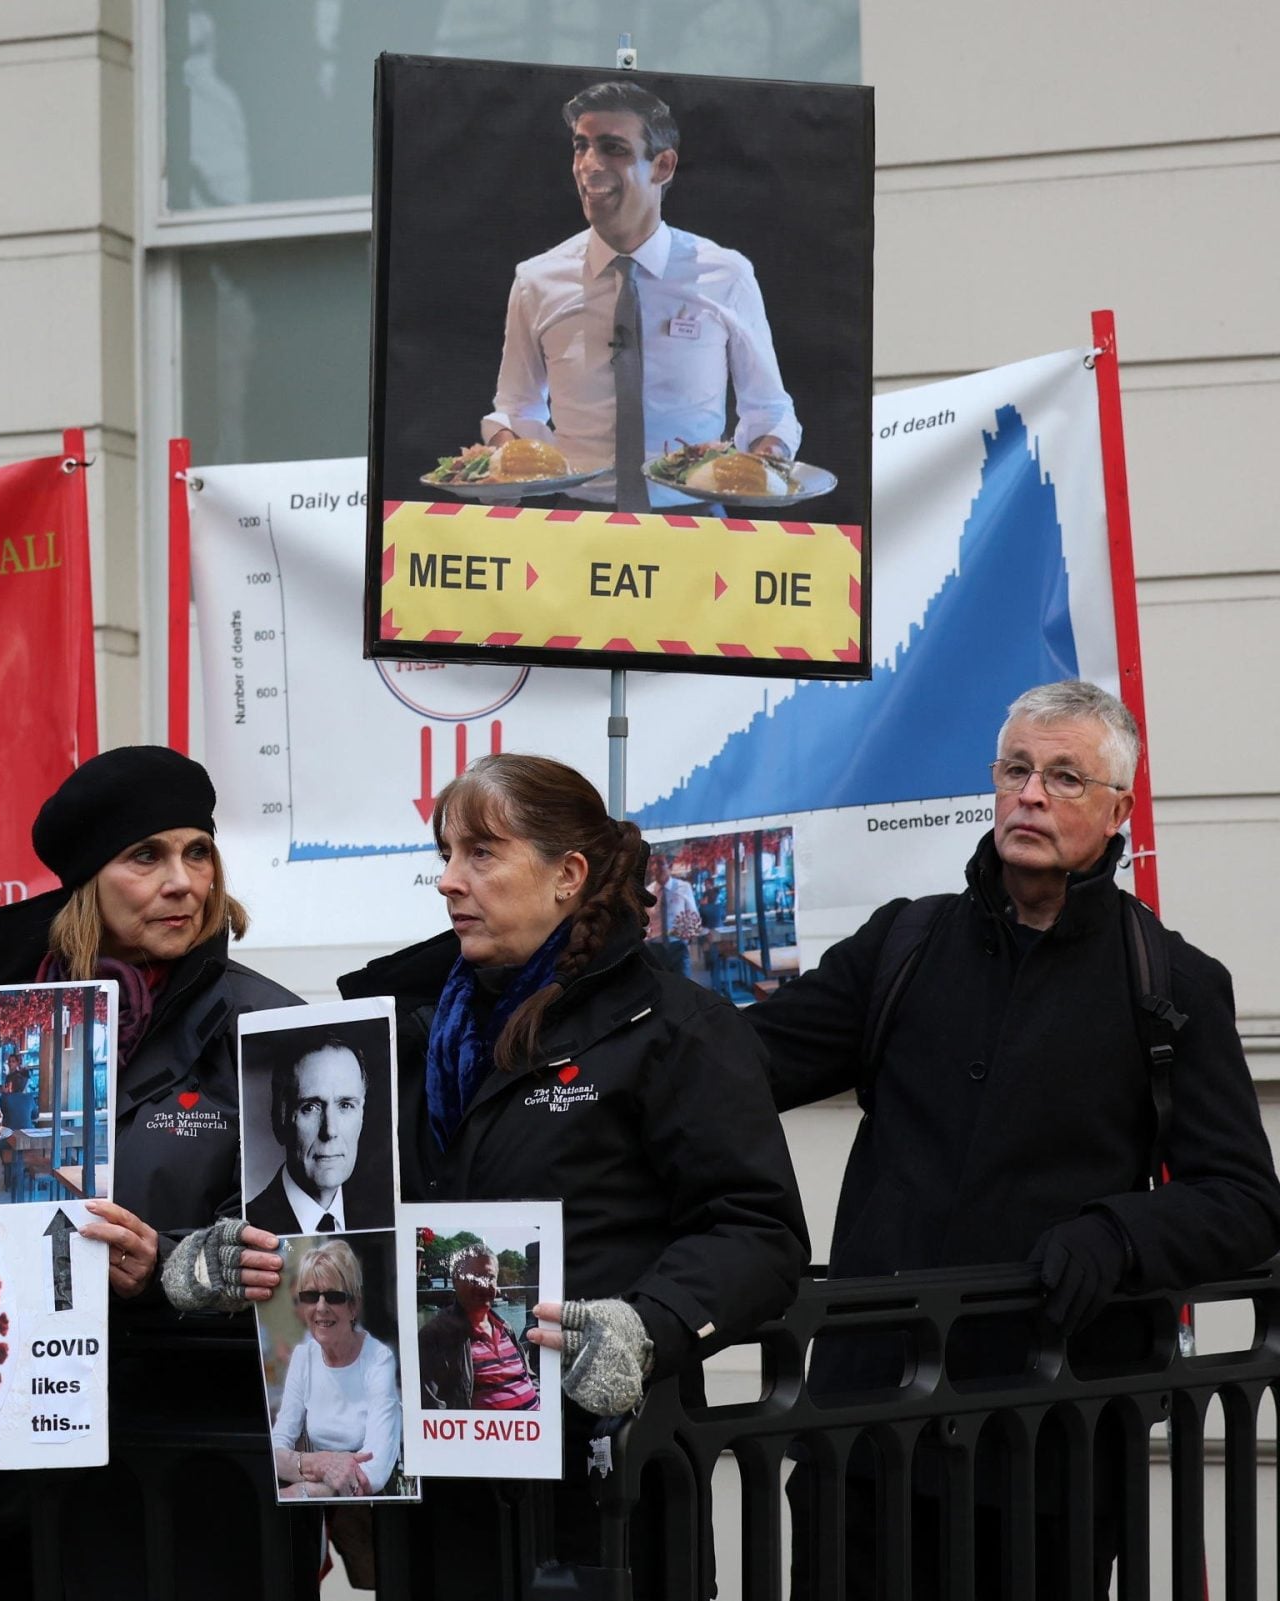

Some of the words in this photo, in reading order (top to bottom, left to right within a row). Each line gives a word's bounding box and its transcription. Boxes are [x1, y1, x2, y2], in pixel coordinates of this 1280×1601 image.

[880, 421, 898, 439] of
[903, 408, 956, 433] death
[290, 491, 341, 512] Daily
[238, 516, 261, 528] 1200
[246, 572, 271, 584] 1000
[409, 552, 511, 591] MEET
[589, 562, 660, 600] EAT
[754, 571, 812, 607] DIE
[230, 610, 243, 653] deaths
[254, 629, 276, 641] 800
[232, 657, 244, 669] of
[234, 674, 246, 724] Number
[256, 687, 278, 699] 600
[259, 744, 280, 756] 400
[262, 802, 282, 814] 200
[867, 813, 951, 832] December
[955, 808, 994, 825] 2020
[272, 858, 279, 868] 0
[533, 1089, 550, 1097] The
[552, 1084, 594, 1095] National
[524, 1095, 549, 1106] Covid
[552, 1092, 599, 1103] Memorial
[549, 1103, 570, 1112] Wall
[154, 1113, 174, 1121] The
[176, 1111, 221, 1120] National
[146, 1120, 174, 1129] Covid
[178, 1119, 228, 1130] Memorial
[175, 1128, 198, 1137] Wall
[31, 1338, 100, 1358] COVID
[31, 1378, 81, 1395] likes
[31, 1414, 91, 1432] this...
[422, 1419, 468, 1440] NOT
[474, 1420, 540, 1441] SAVED
